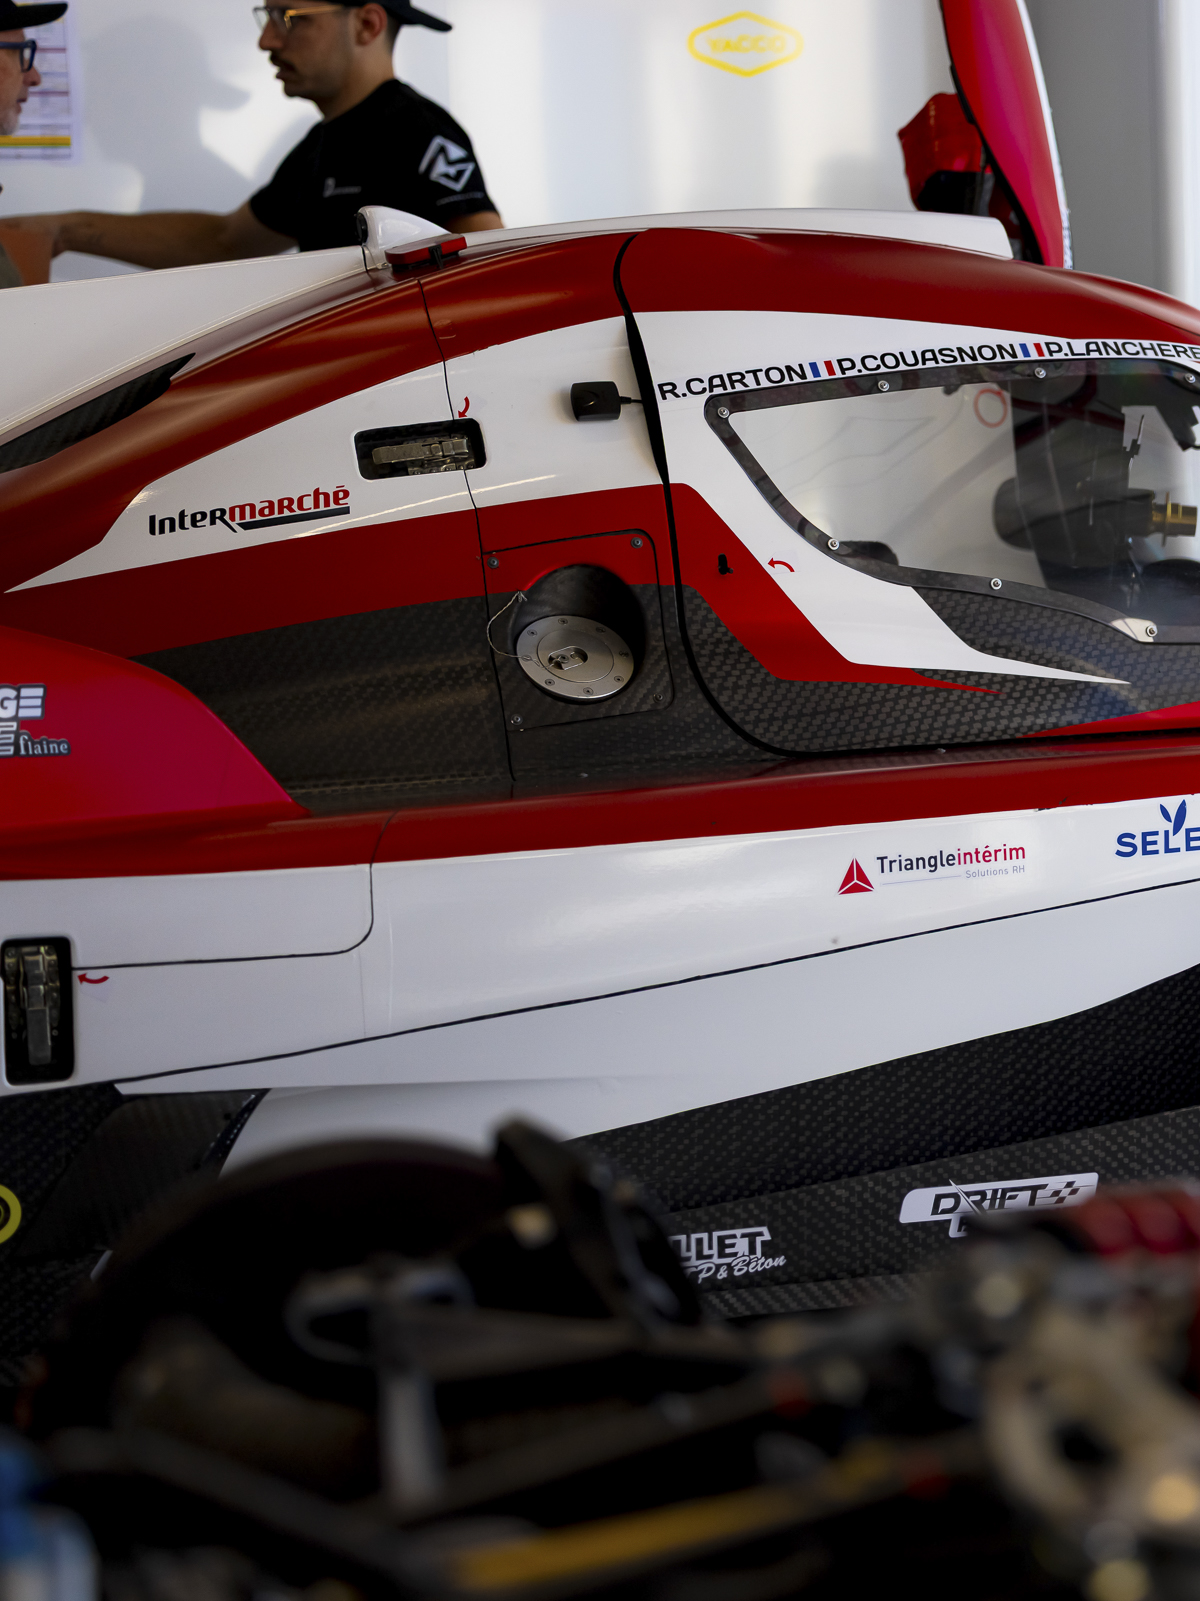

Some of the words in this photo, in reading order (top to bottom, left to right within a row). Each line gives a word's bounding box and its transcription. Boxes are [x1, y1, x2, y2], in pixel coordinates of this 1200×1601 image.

[656, 362, 808, 401] R.CARTON
[836, 342, 1019, 376] P.COUASNON
[148, 485, 351, 536] Intermarché
[20, 735, 68, 755] flaine
[965, 867, 1009, 879] Solutions
[1012, 865, 1026, 874] RH
[930, 1183, 1049, 1216] DRIFT
[717, 1265, 728, 1280] &
